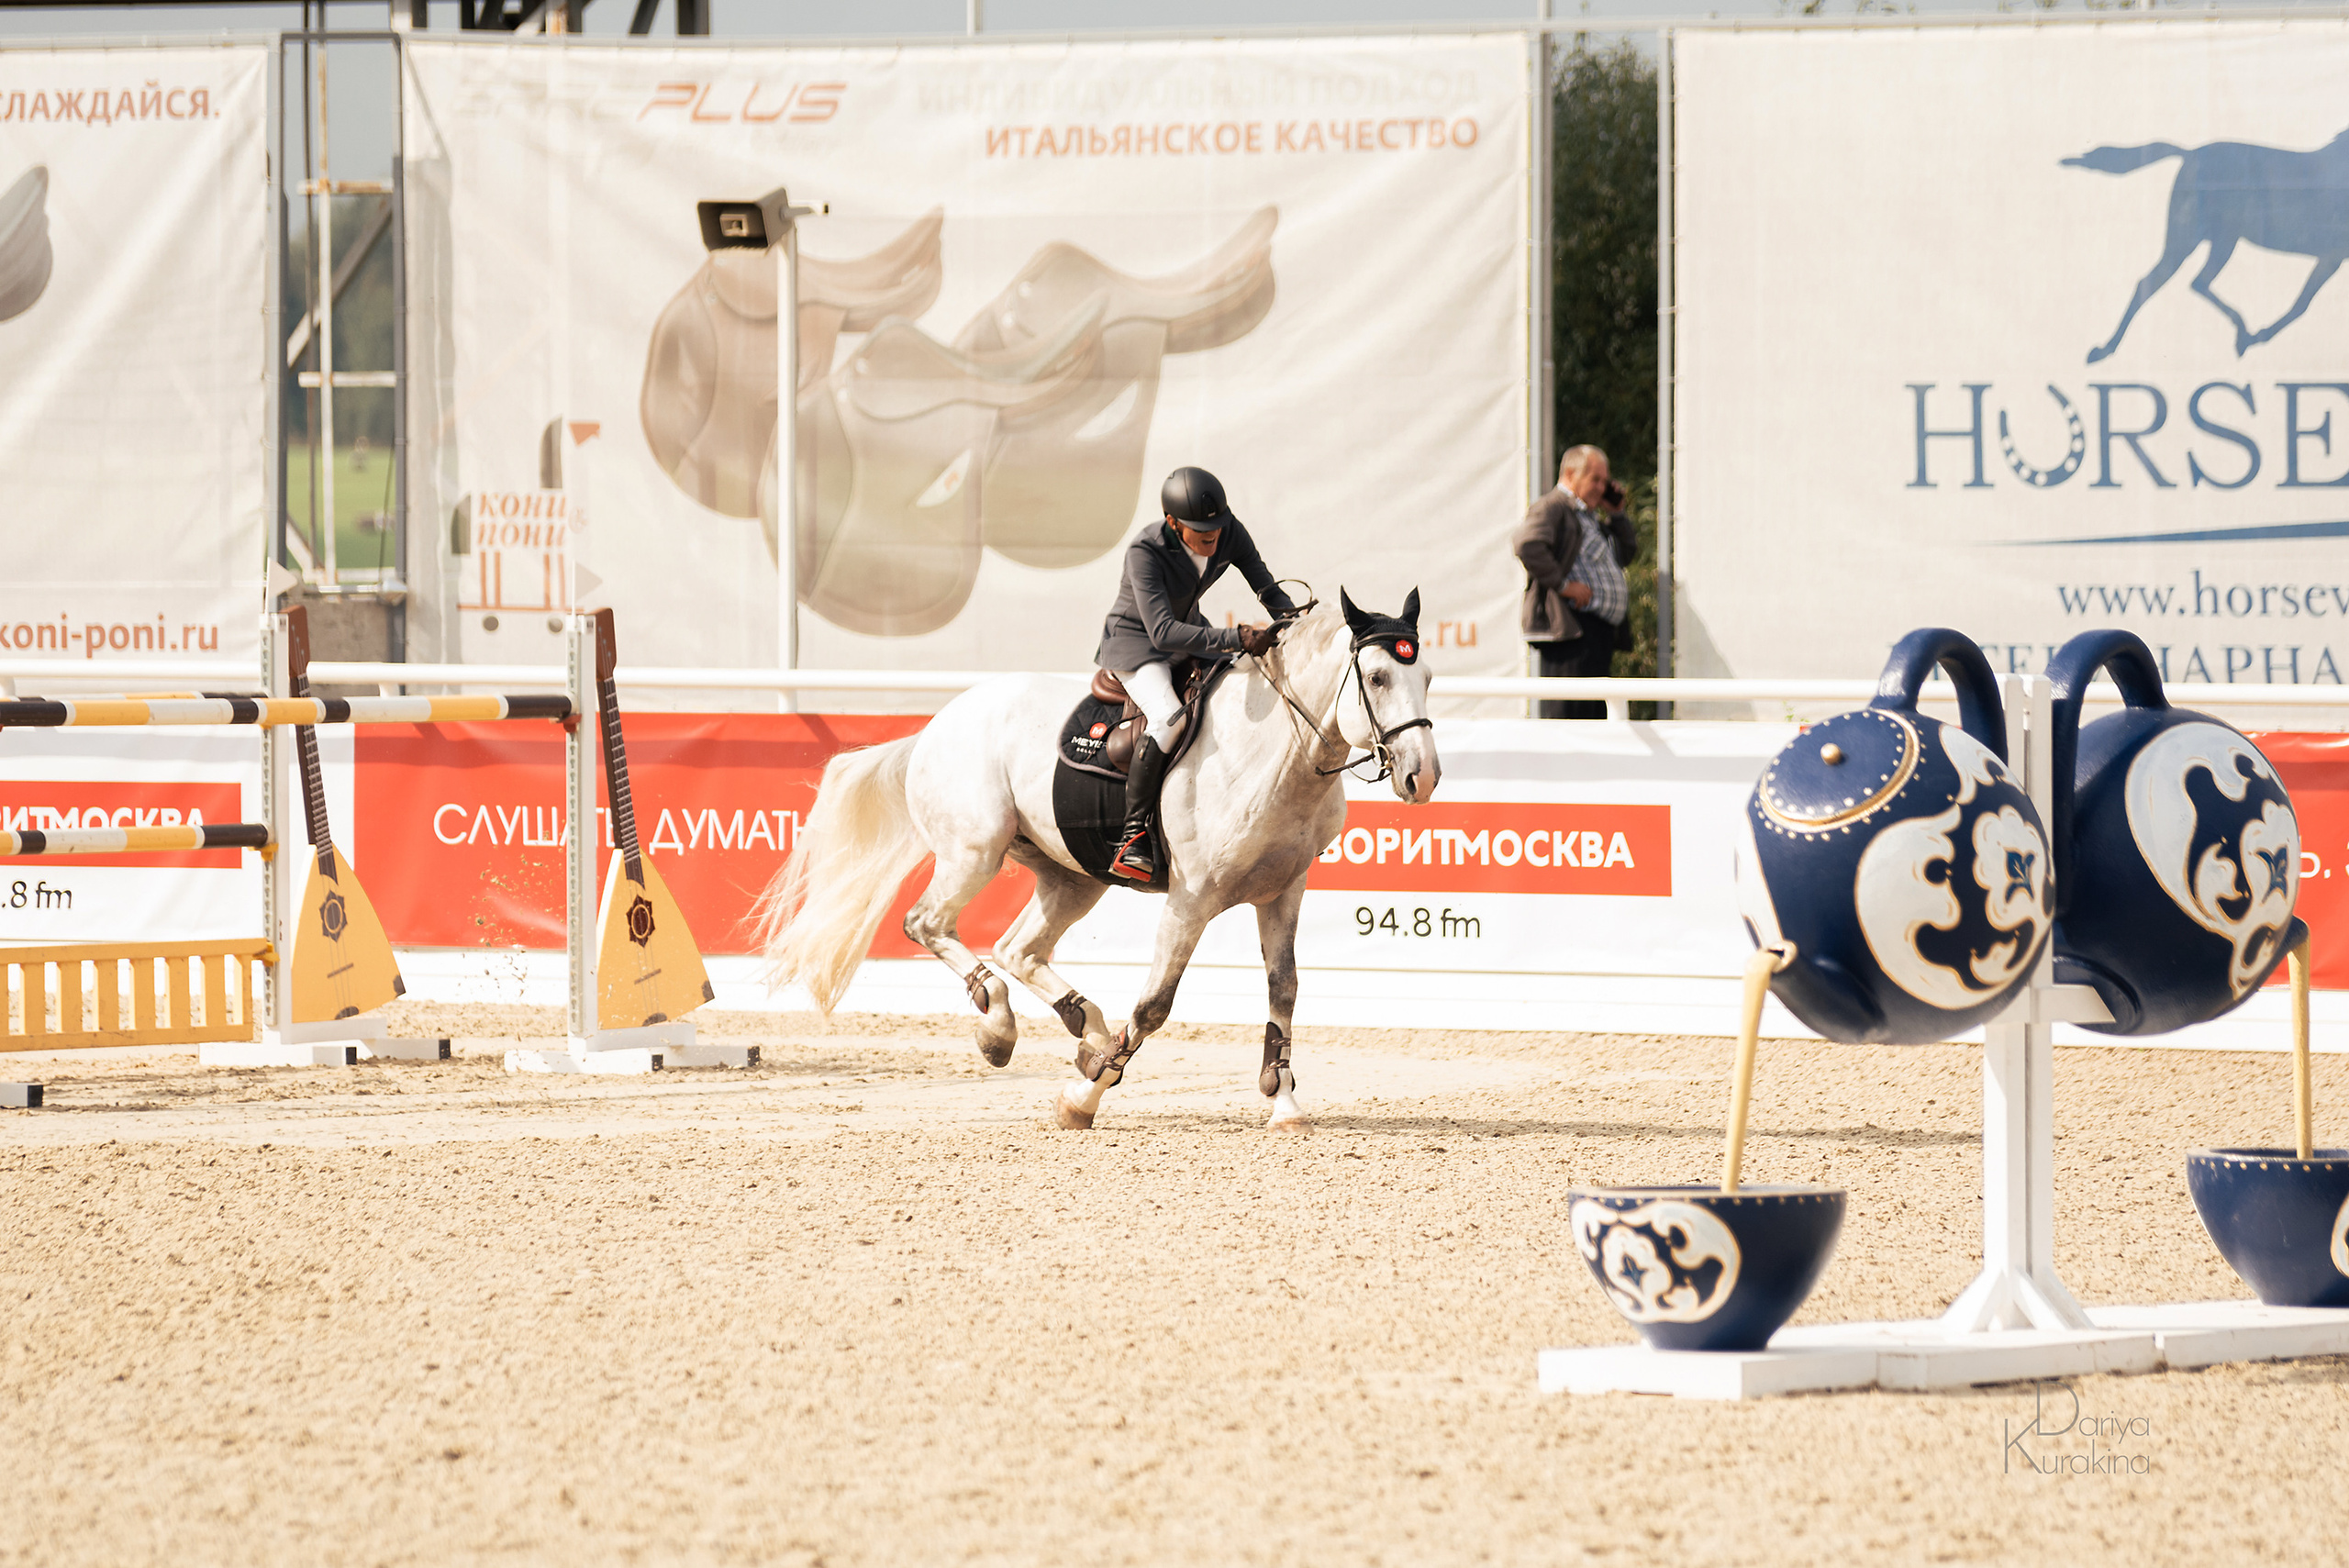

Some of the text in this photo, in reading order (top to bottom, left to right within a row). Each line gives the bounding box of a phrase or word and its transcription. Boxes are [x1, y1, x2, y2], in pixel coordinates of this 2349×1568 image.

[0, 80, 220, 127] ЛАЖДАЙСЯ.
[637, 83, 847, 122] PLUS
[985, 117, 1479, 157] ИТАЛЬЯНСКОЕ КАЧЕСТВО
[0, 806, 204, 831] ИТМОСКВА
[35, 881, 72, 908] fm
[1355, 906, 1481, 938] 94.8 fm
